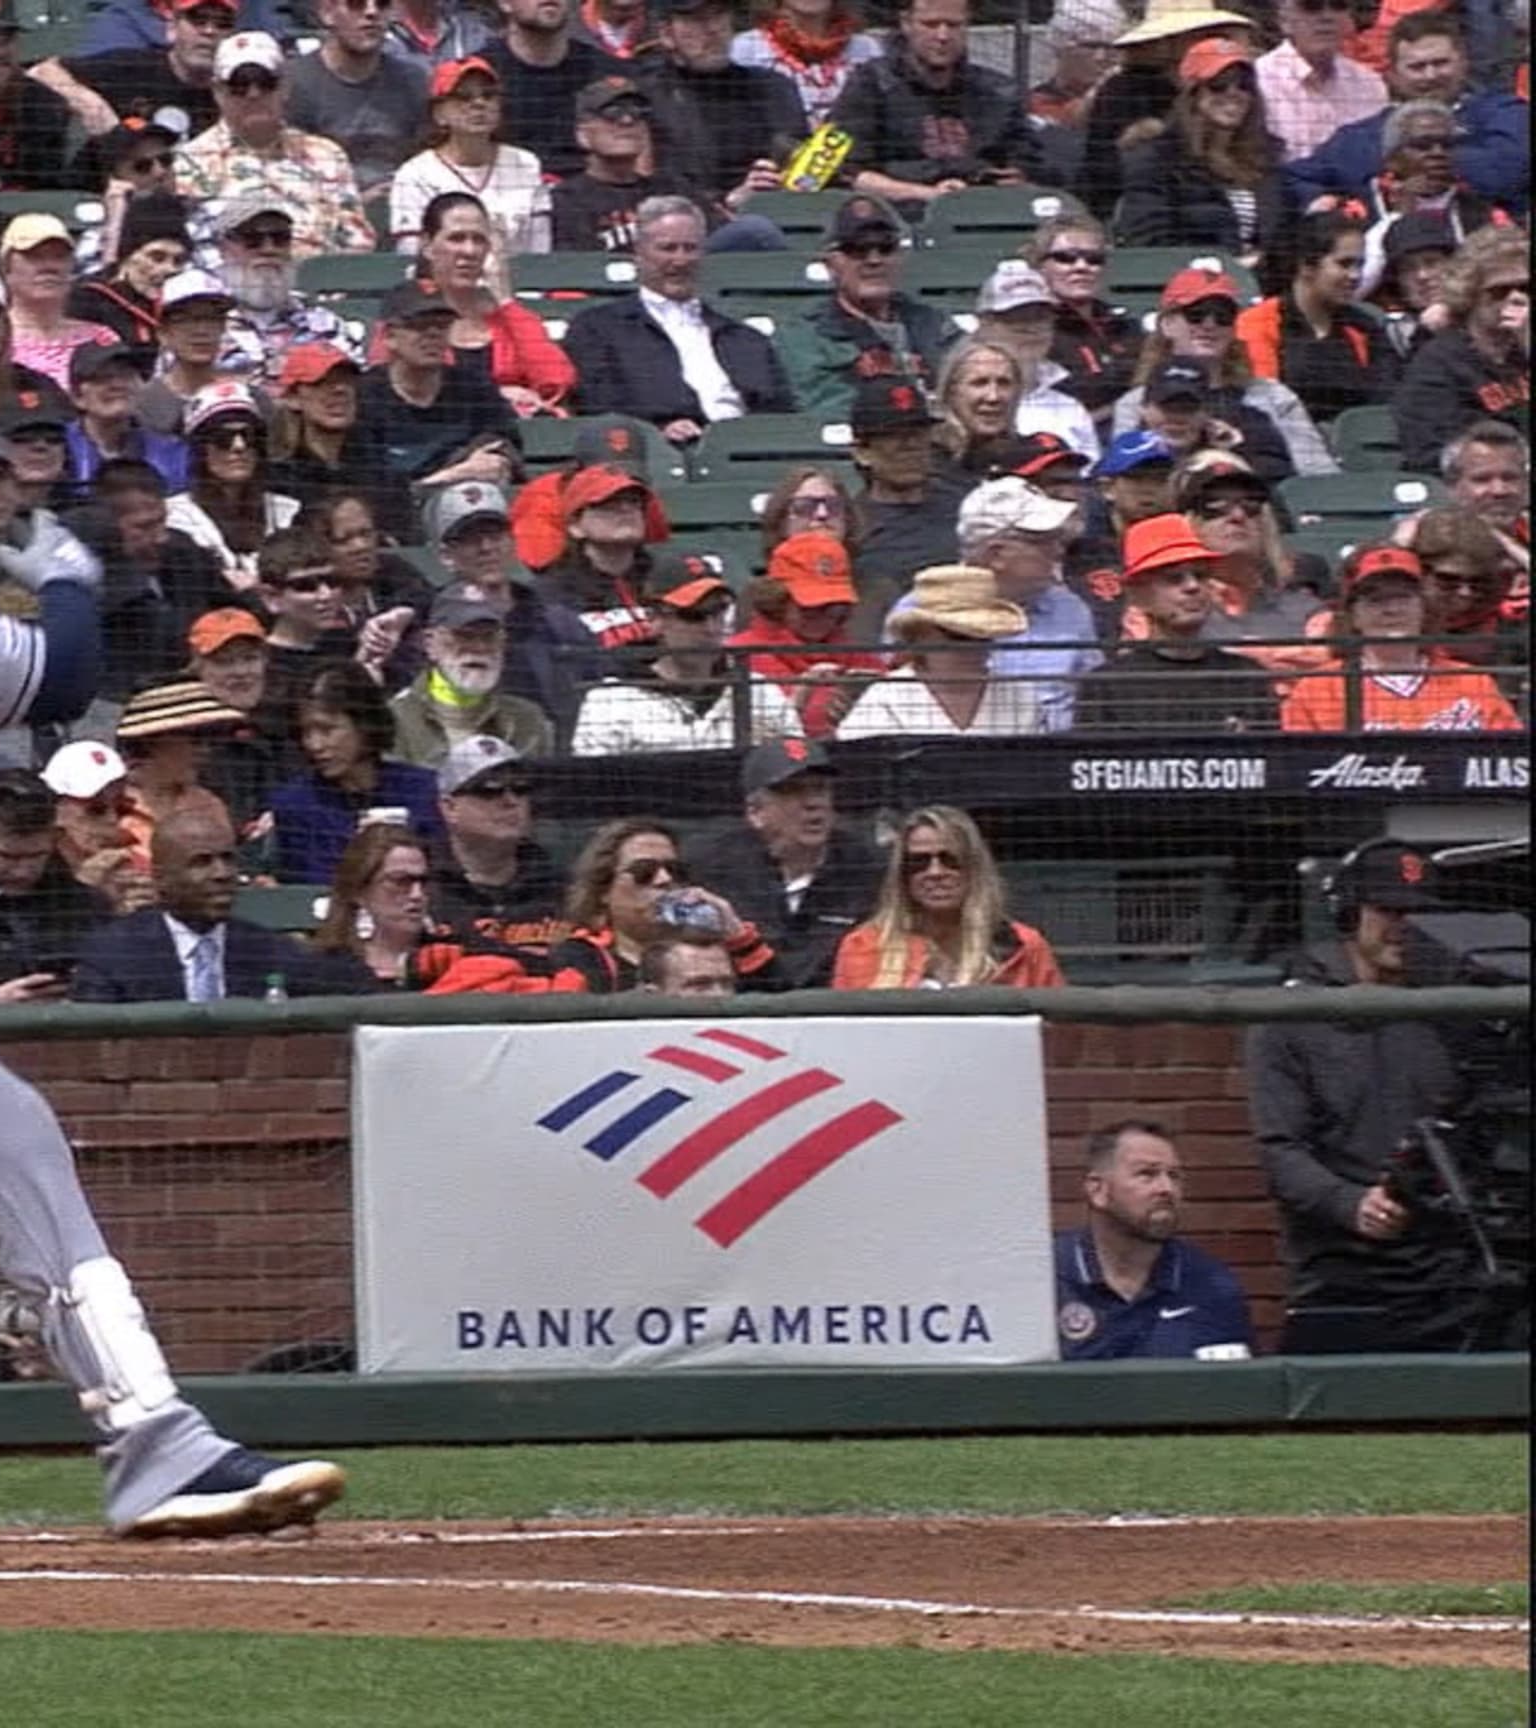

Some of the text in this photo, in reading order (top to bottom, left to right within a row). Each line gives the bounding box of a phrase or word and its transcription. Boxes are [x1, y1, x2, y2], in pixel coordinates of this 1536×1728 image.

[1071, 758, 1266, 790] SFGIANTS.COM
[1309, 753, 1422, 791] Alaska
[458, 1303, 992, 1349] BANK OF AMERICA
